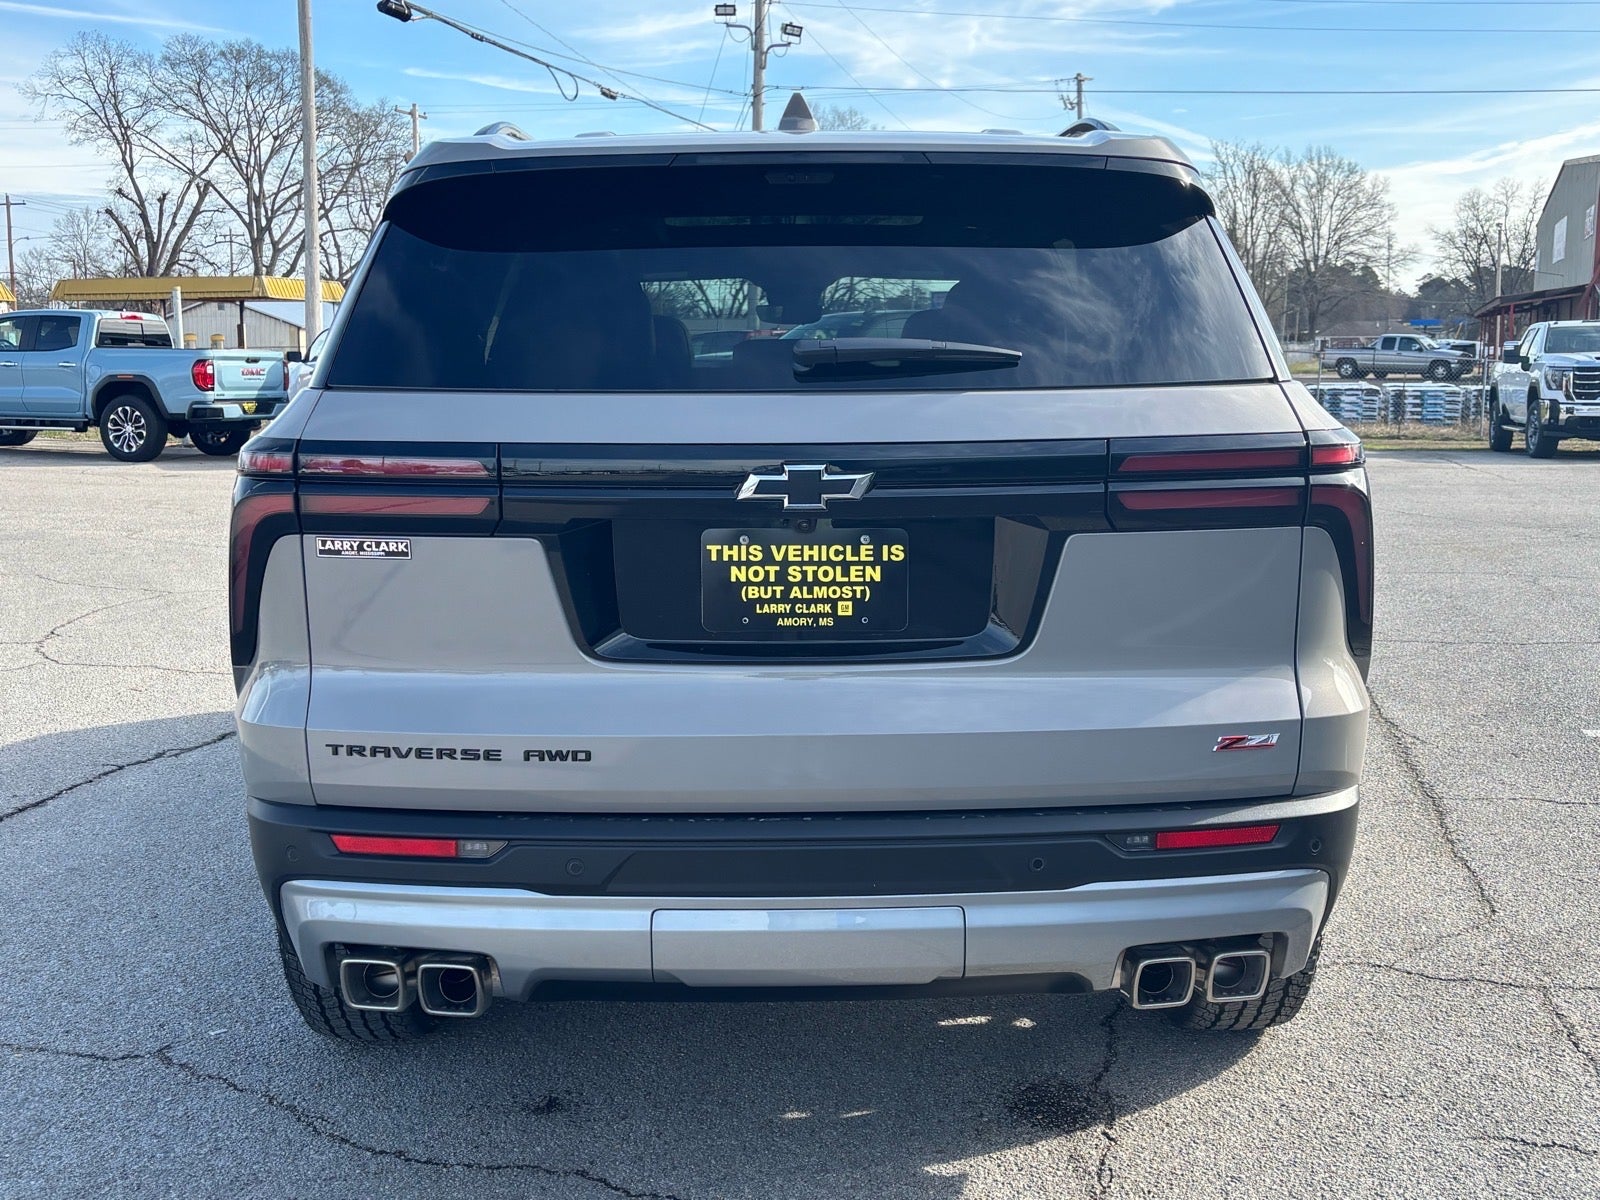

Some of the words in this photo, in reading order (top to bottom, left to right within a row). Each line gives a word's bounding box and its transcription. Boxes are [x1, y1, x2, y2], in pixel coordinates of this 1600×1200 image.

[241, 368, 266, 376] GMC
[318, 540, 360, 551] LARRY
[363, 542, 408, 552] CLARK
[706, 545, 763, 562] THIS
[770, 545, 874, 562] VEHICLE
[882, 545, 905, 562] IS
[730, 565, 780, 582] NOT
[787, 565, 881, 582] STOLEN
[741, 586, 784, 602] (BUT
[789, 586, 871, 602] ALMOST)
[756, 603, 791, 614] LARRY
[795, 603, 832, 614] CLARK
[776, 617, 816, 627] AMORY,
[819, 617, 834, 627] MS
[1212, 732, 1281, 752] Z71
[325, 743, 503, 762] TRAVERSE
[523, 749, 593, 762] AWD
